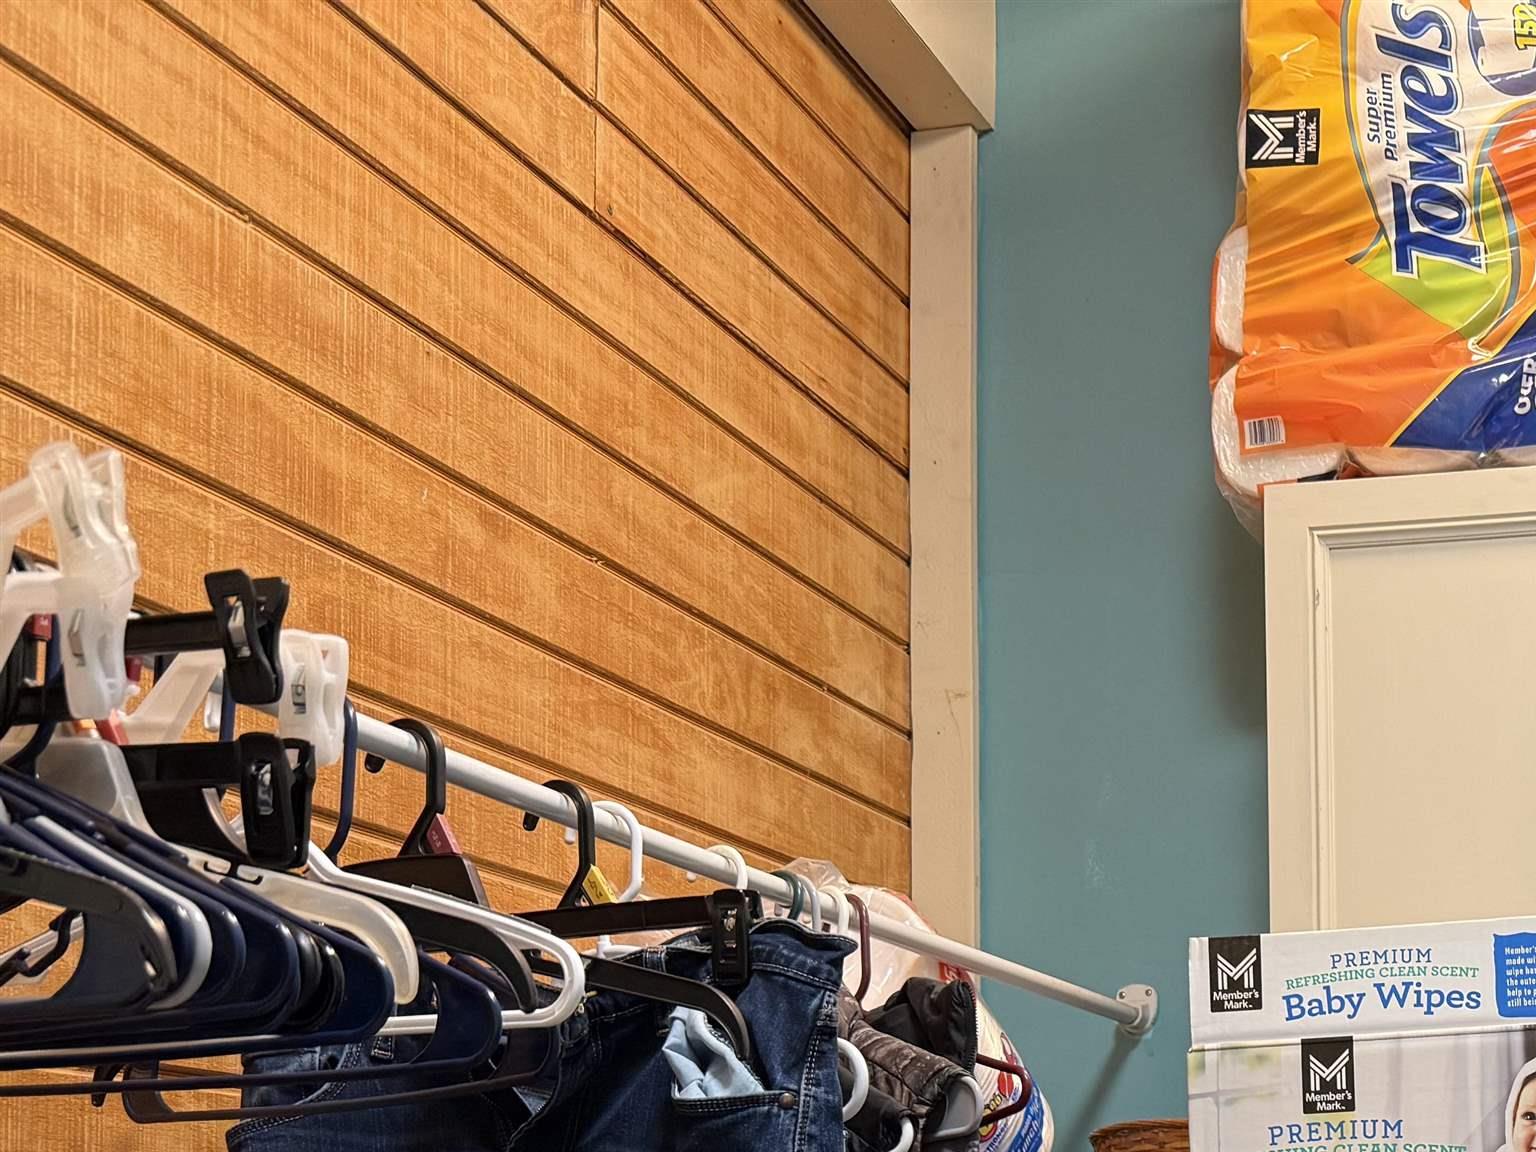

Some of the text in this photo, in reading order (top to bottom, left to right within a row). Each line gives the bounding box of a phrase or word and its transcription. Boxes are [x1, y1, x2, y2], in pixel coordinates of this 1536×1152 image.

[1367, 86, 1381, 144] Super
[1385, 72, 1399, 162] Premium
[1294, 110, 1307, 164] Member's
[1391, 0, 1487, 280] Towels
[1329, 947, 1433, 970] PREMIUM
[1212, 989, 1260, 1002] Member's
[1285, 965, 1480, 991] REFRESHING CLEAN SCENT
[1281, 980, 1483, 1022] Baby Wipes
[1305, 1090, 1353, 1103] Member's
[1268, 1119, 1404, 1147] PREMIUM
